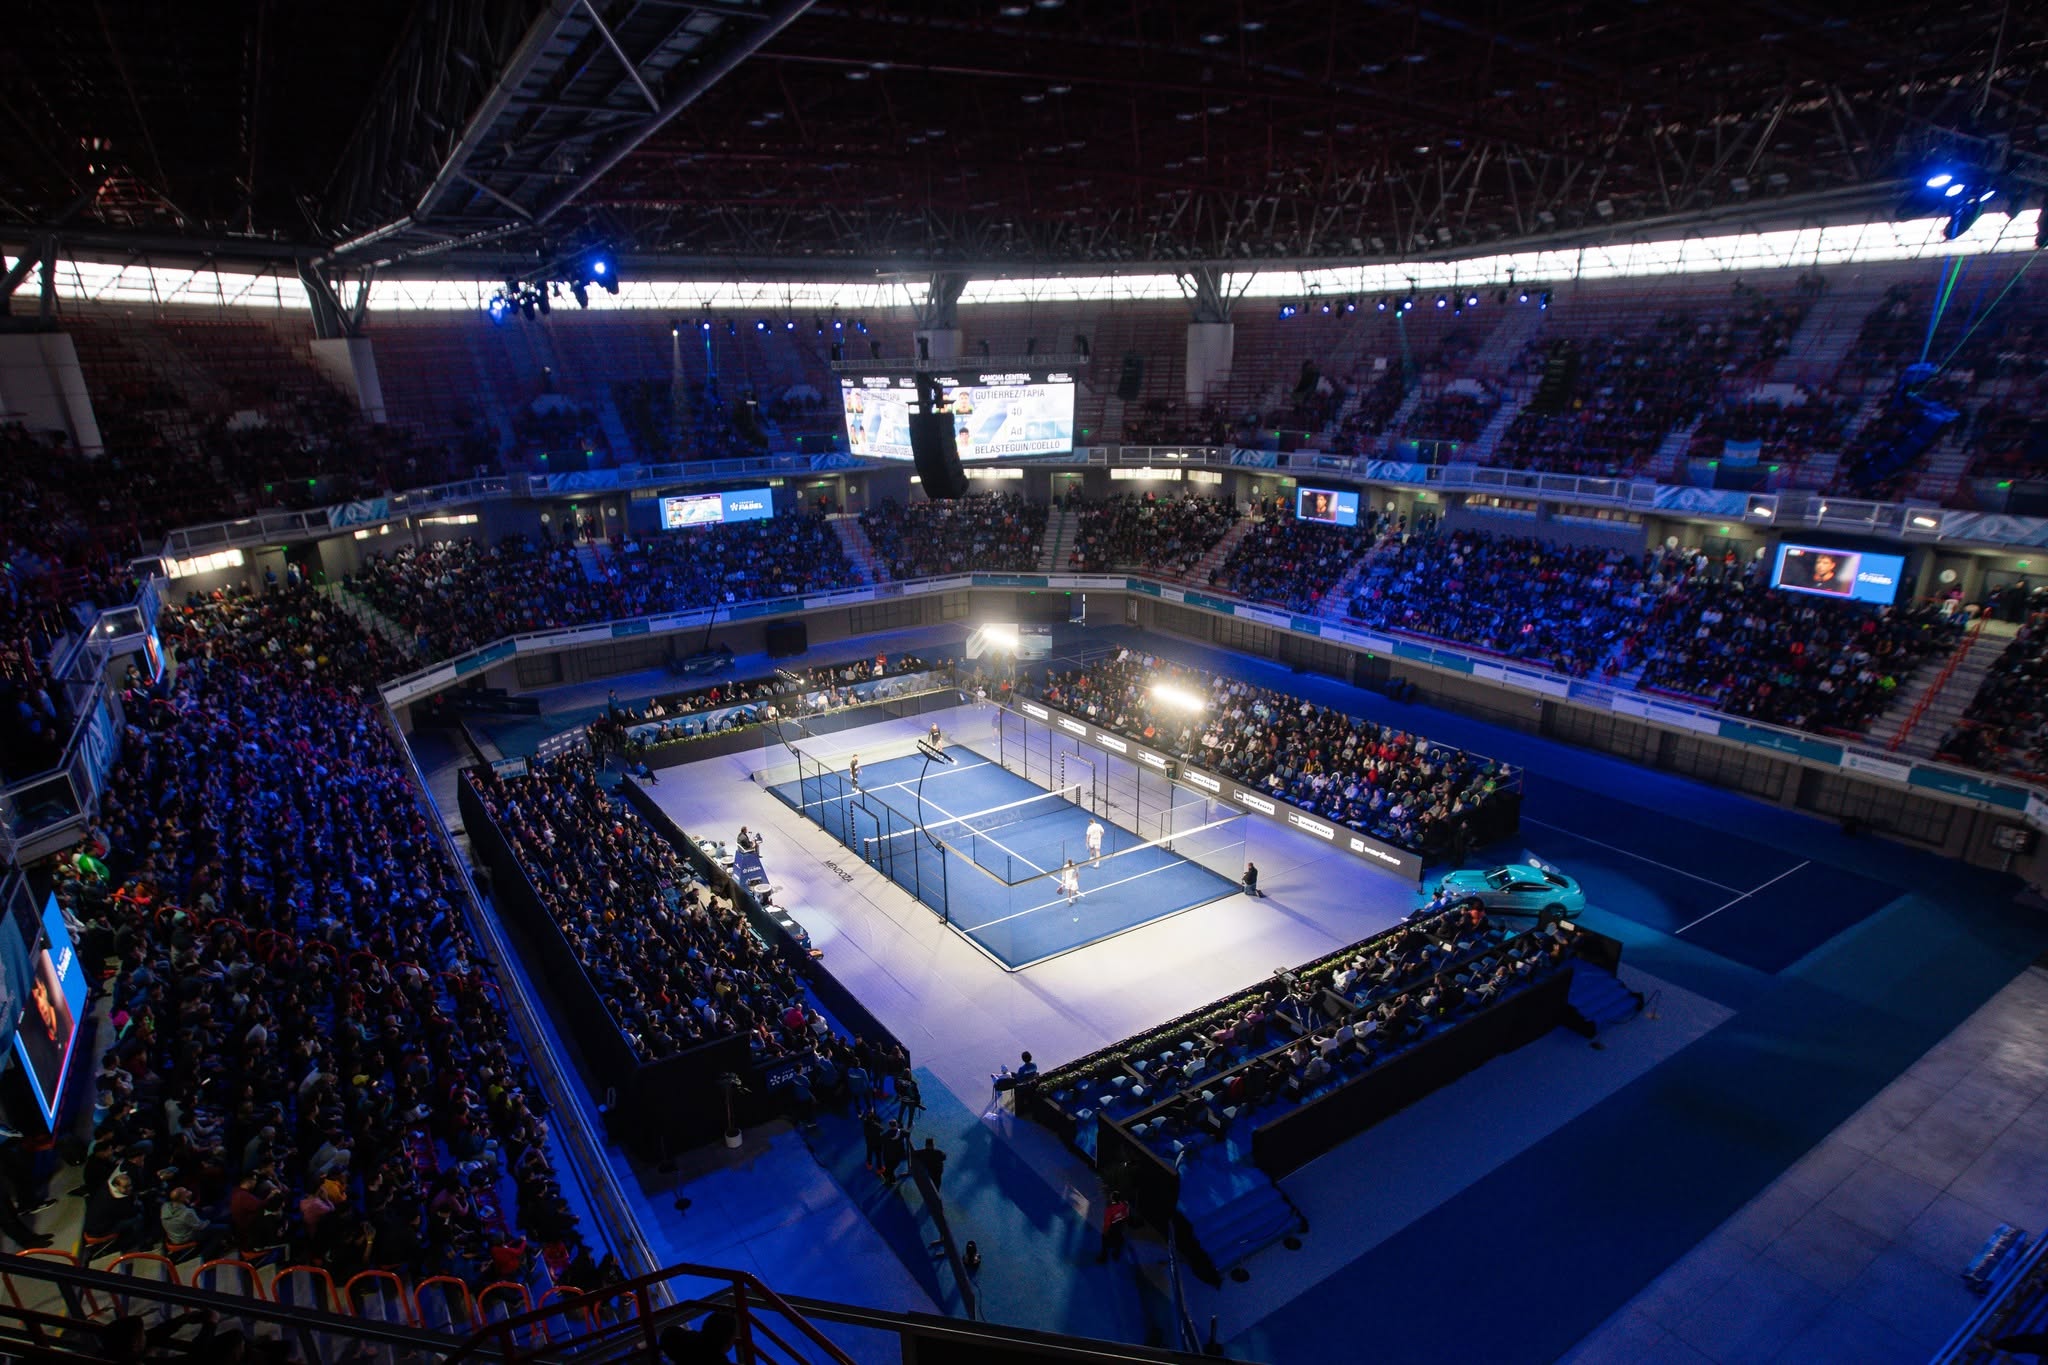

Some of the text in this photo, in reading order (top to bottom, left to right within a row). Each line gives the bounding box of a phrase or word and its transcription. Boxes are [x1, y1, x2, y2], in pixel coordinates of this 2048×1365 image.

[1005, 373, 1031, 381] CENTRAL
[975, 389, 1045, 399] GUTIERREZ/TAPIA
[1011, 407, 1022, 417] 40
[975, 441, 1060, 455] BELASTEGUIN/COELLO
[825, 860, 853, 883] MENDOZA
